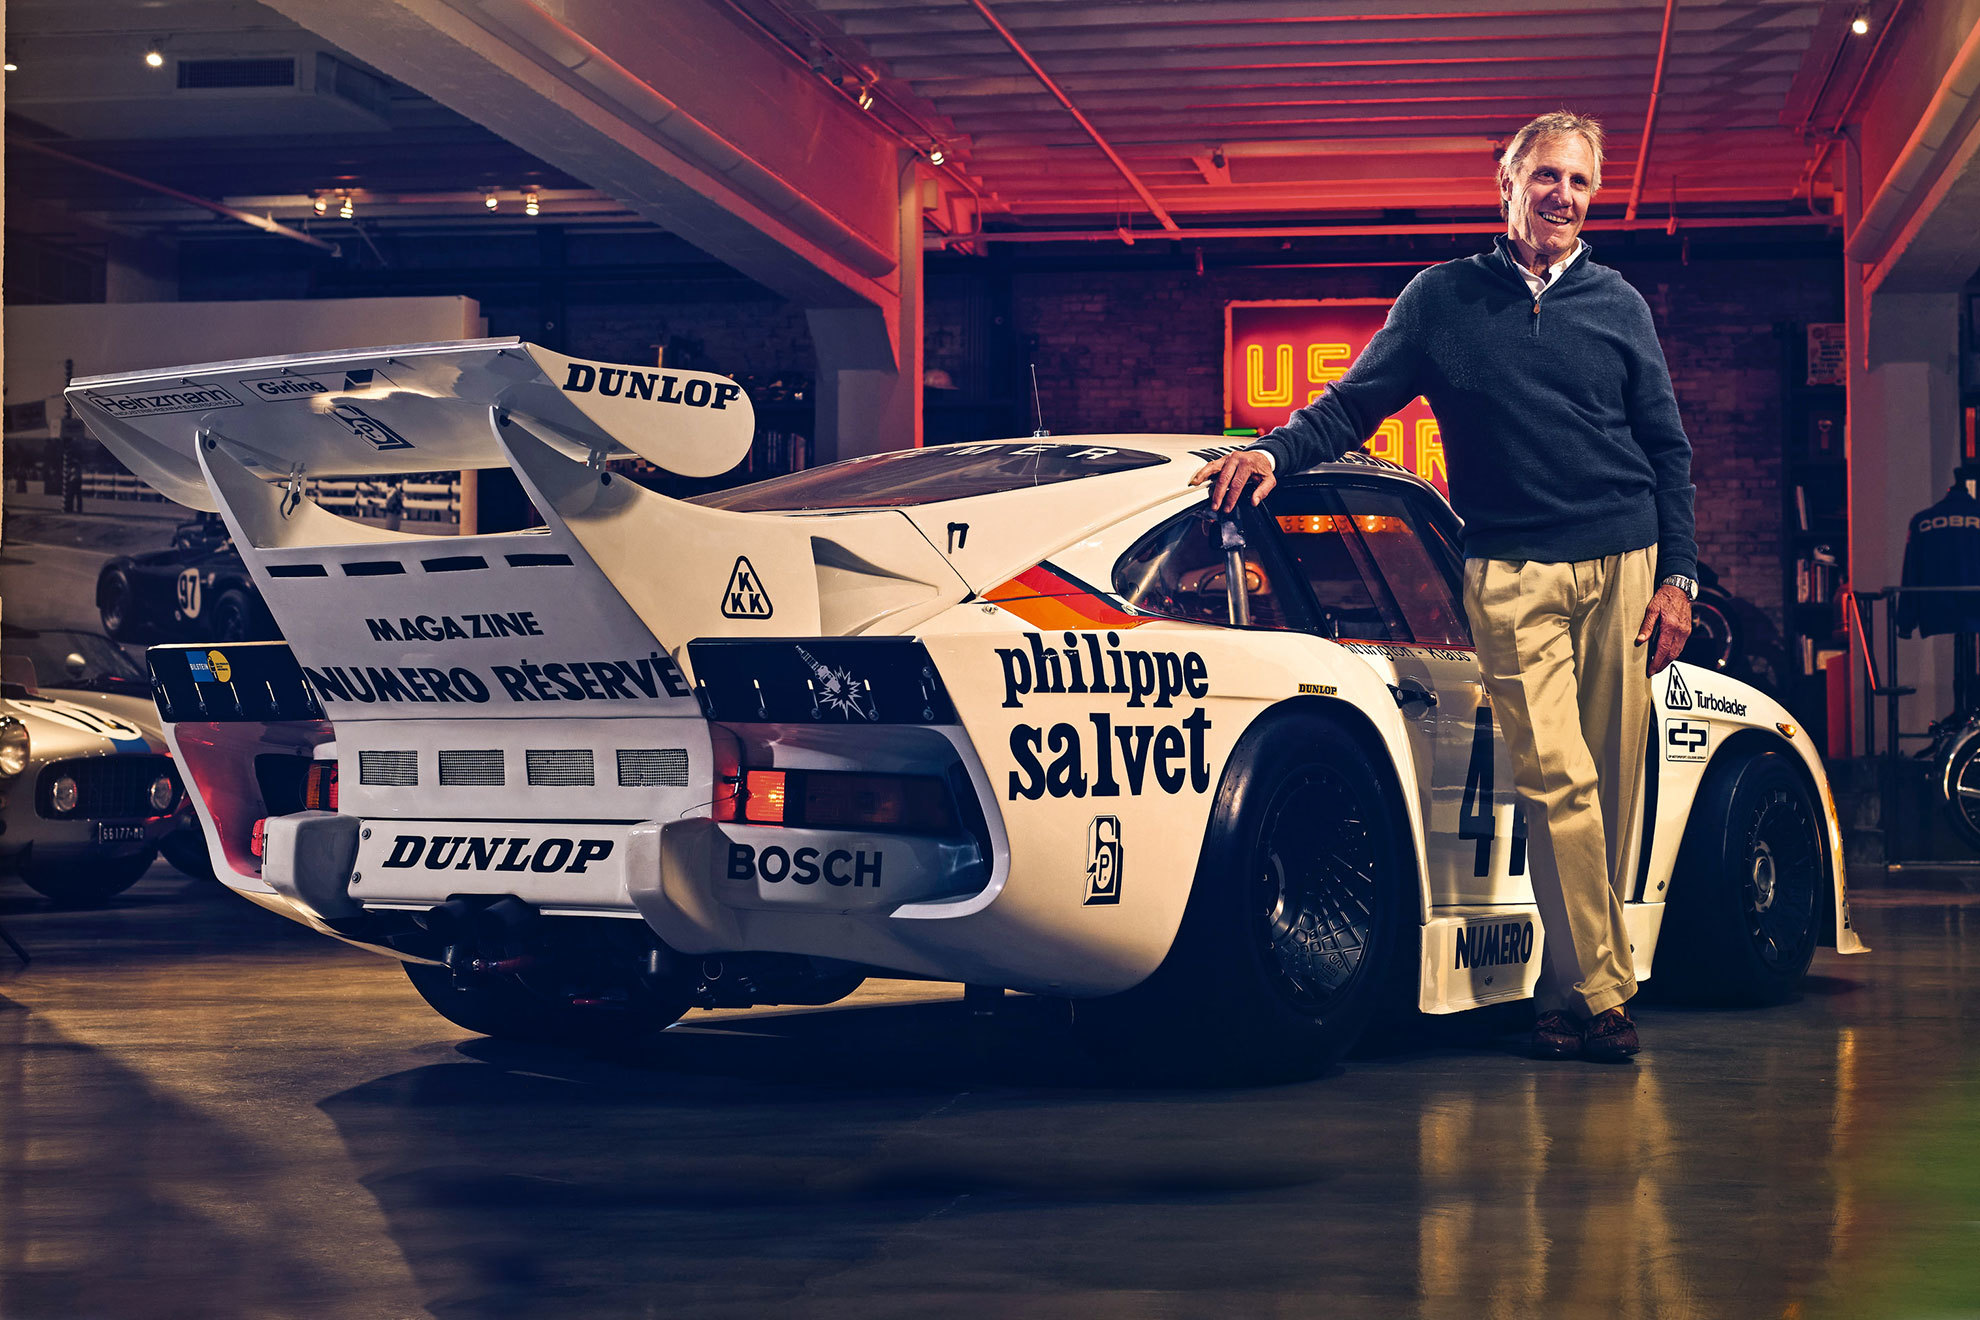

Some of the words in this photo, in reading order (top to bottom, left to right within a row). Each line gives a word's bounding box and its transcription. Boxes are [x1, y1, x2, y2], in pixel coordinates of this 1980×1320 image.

[257, 380, 329, 395] Girling
[562, 363, 741, 410] DUNLOP
[1247, 343, 1370, 408] US
[94, 389, 232, 413] Heinzmann
[1919, 515, 1980, 532] COBR
[180, 574, 198, 610] 97
[365, 611, 544, 642] MAGAZINE
[302, 666, 491, 703] NUMERO
[491, 652, 691, 702] RÉSERVÉ
[994, 631, 1209, 708] philippe
[1299, 684, 1337, 695] DUNLOP
[1694, 690, 1747, 717] Turbolader
[1009, 707, 1212, 800] salvet
[381, 835, 615, 873] DUNLOP
[727, 844, 882, 888] BOSCH
[1455, 921, 1534, 969] NUMERO
